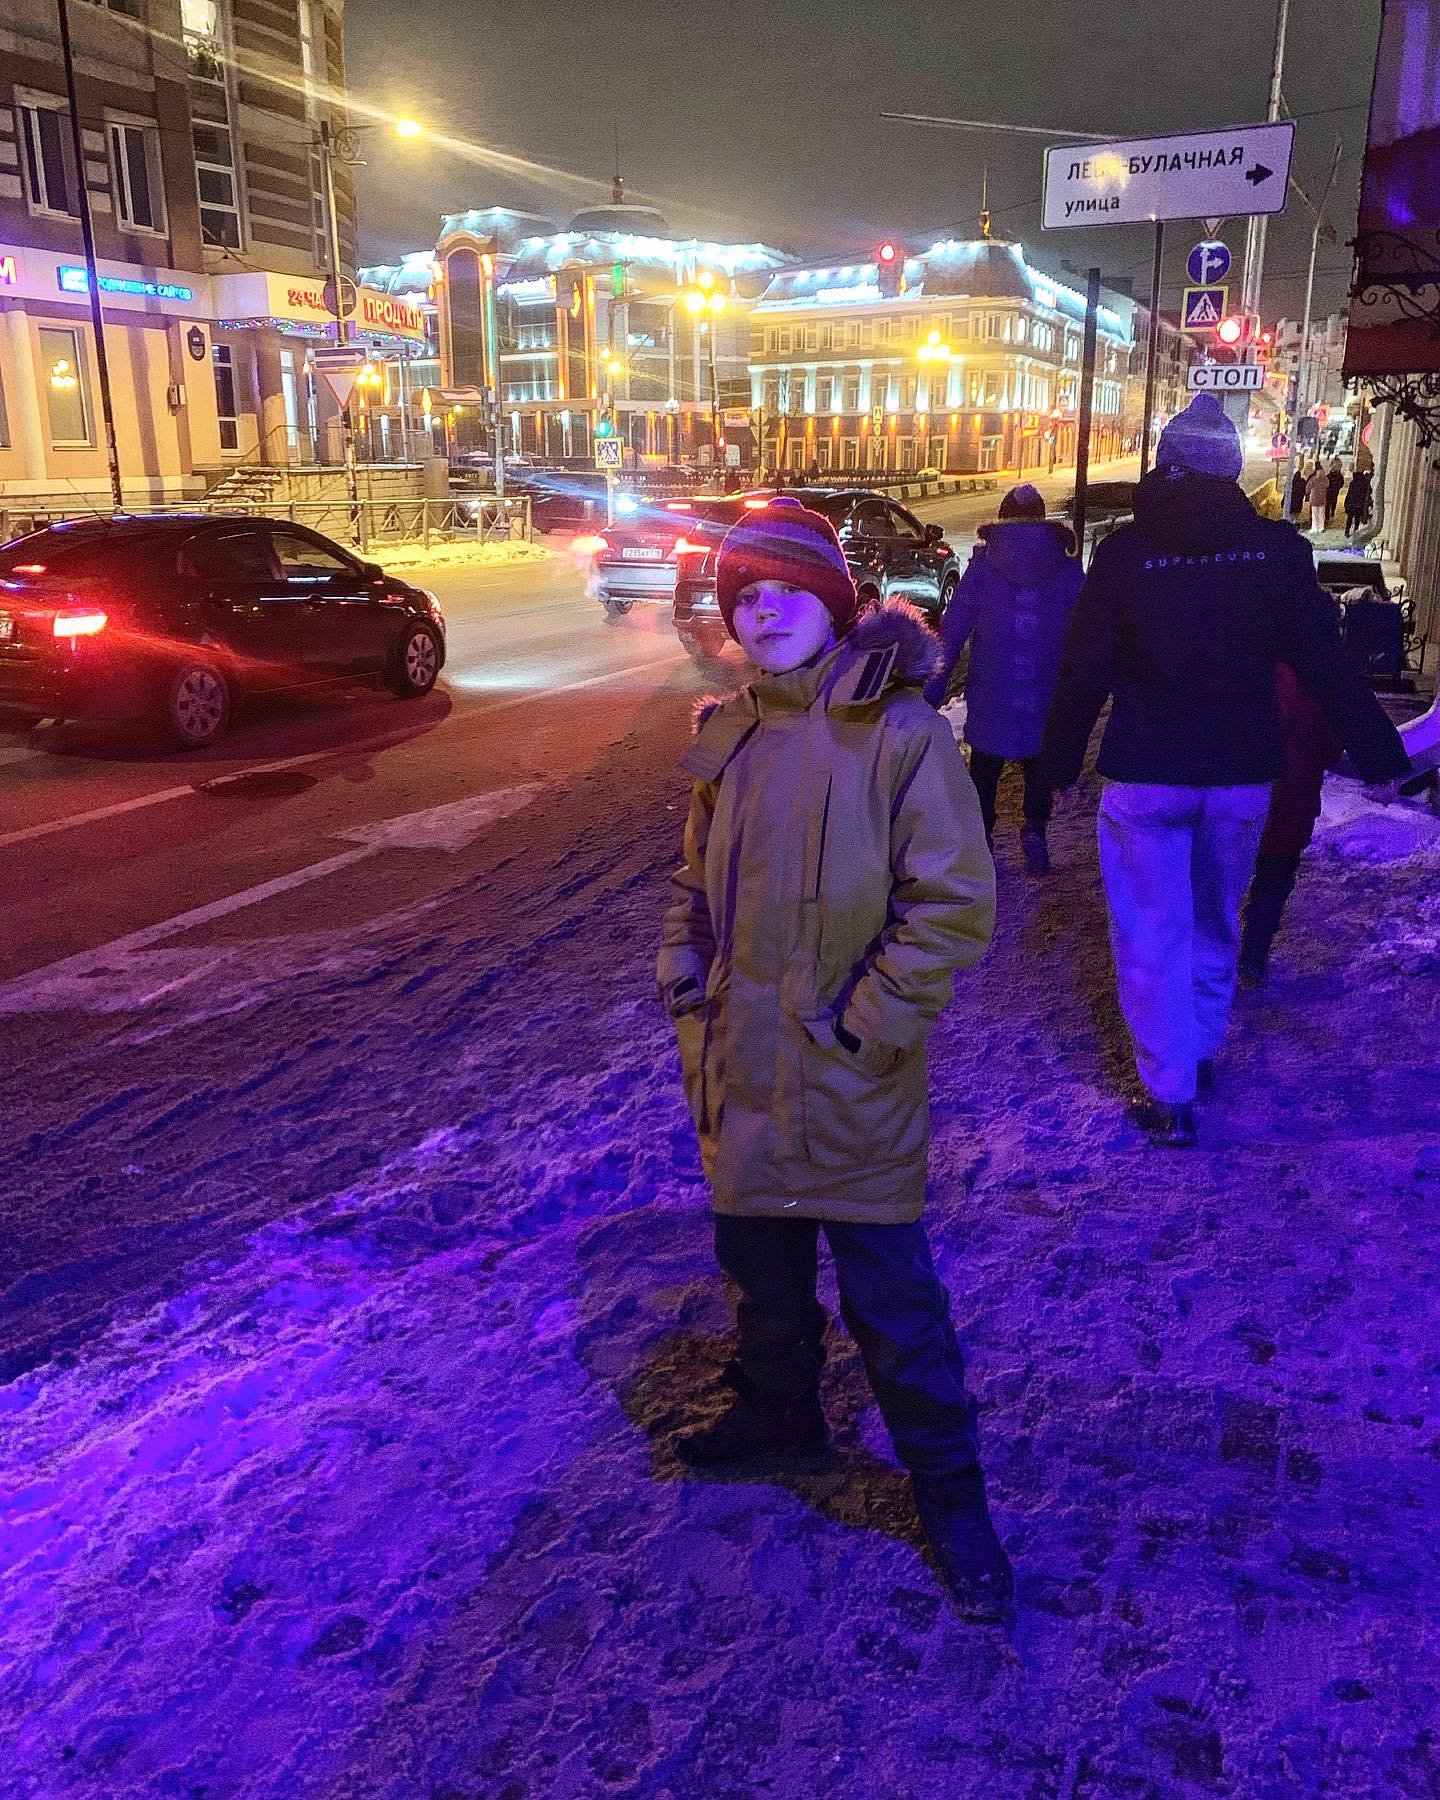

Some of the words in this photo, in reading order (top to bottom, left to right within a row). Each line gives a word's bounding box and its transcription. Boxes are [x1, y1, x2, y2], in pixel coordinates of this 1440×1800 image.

[1067, 146, 1245, 181] ЛЕ-БУЛАЧНАЯ
[1065, 196, 1121, 217] улица
[288, 288, 305, 307] 24
[364, 296, 424, 330] ПРОДУКТЫ
[1193, 368, 1258, 386] СТОП
